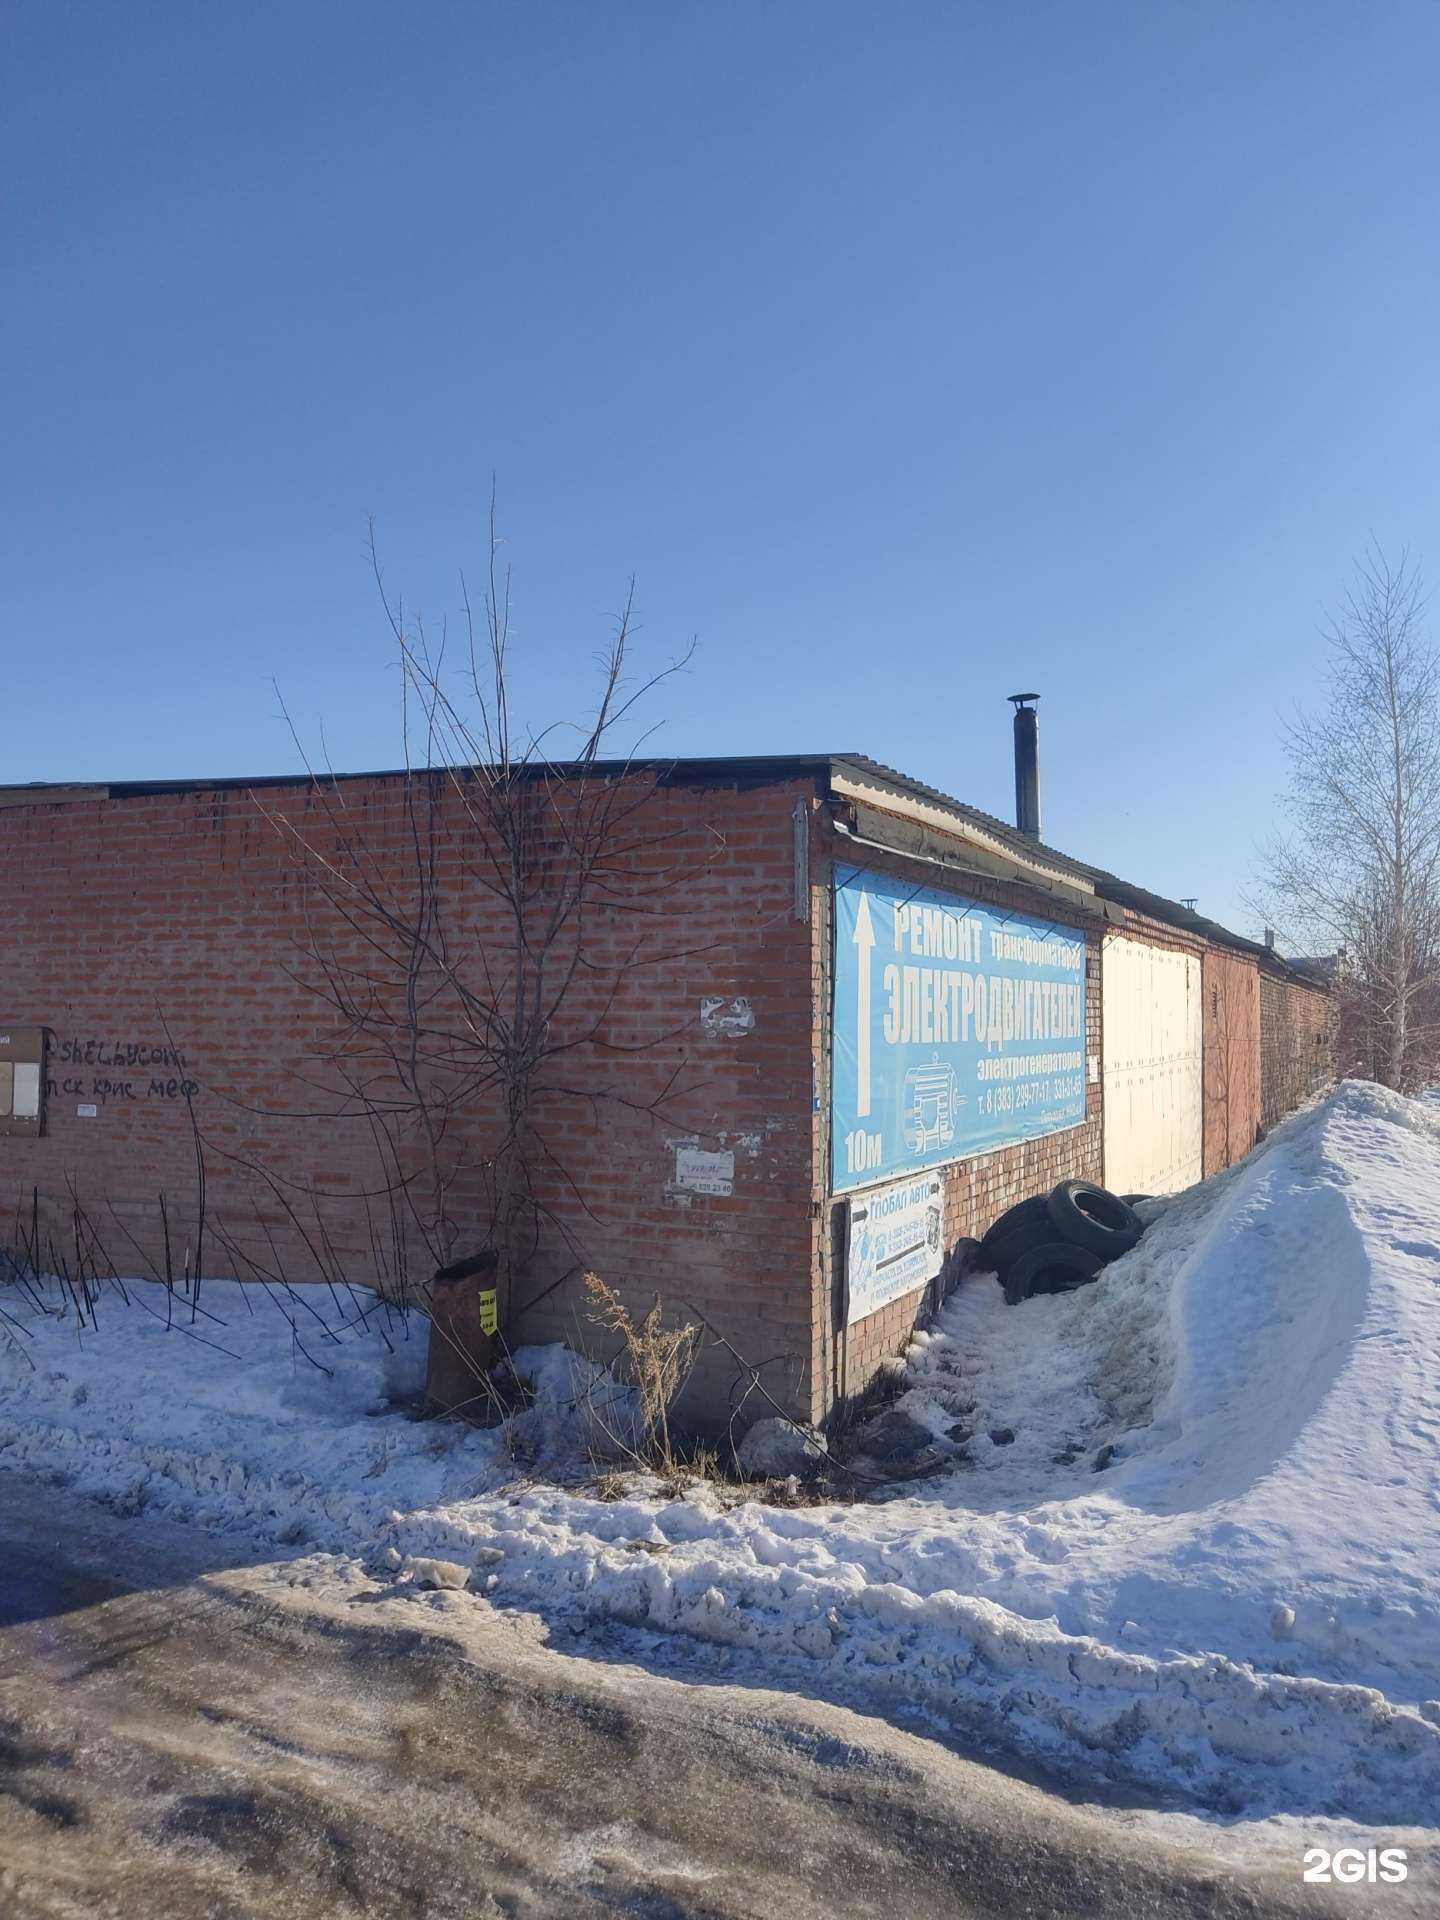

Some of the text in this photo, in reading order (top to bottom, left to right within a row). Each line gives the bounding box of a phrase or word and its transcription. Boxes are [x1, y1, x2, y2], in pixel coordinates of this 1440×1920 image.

[894, 901, 983, 963] РЕМОНТ
[883, 964, 1081, 1052] ЭЛЕКТРОДВИГАТЕЛЕЙ
[977, 1051, 1082, 1080] электрогенераторов
